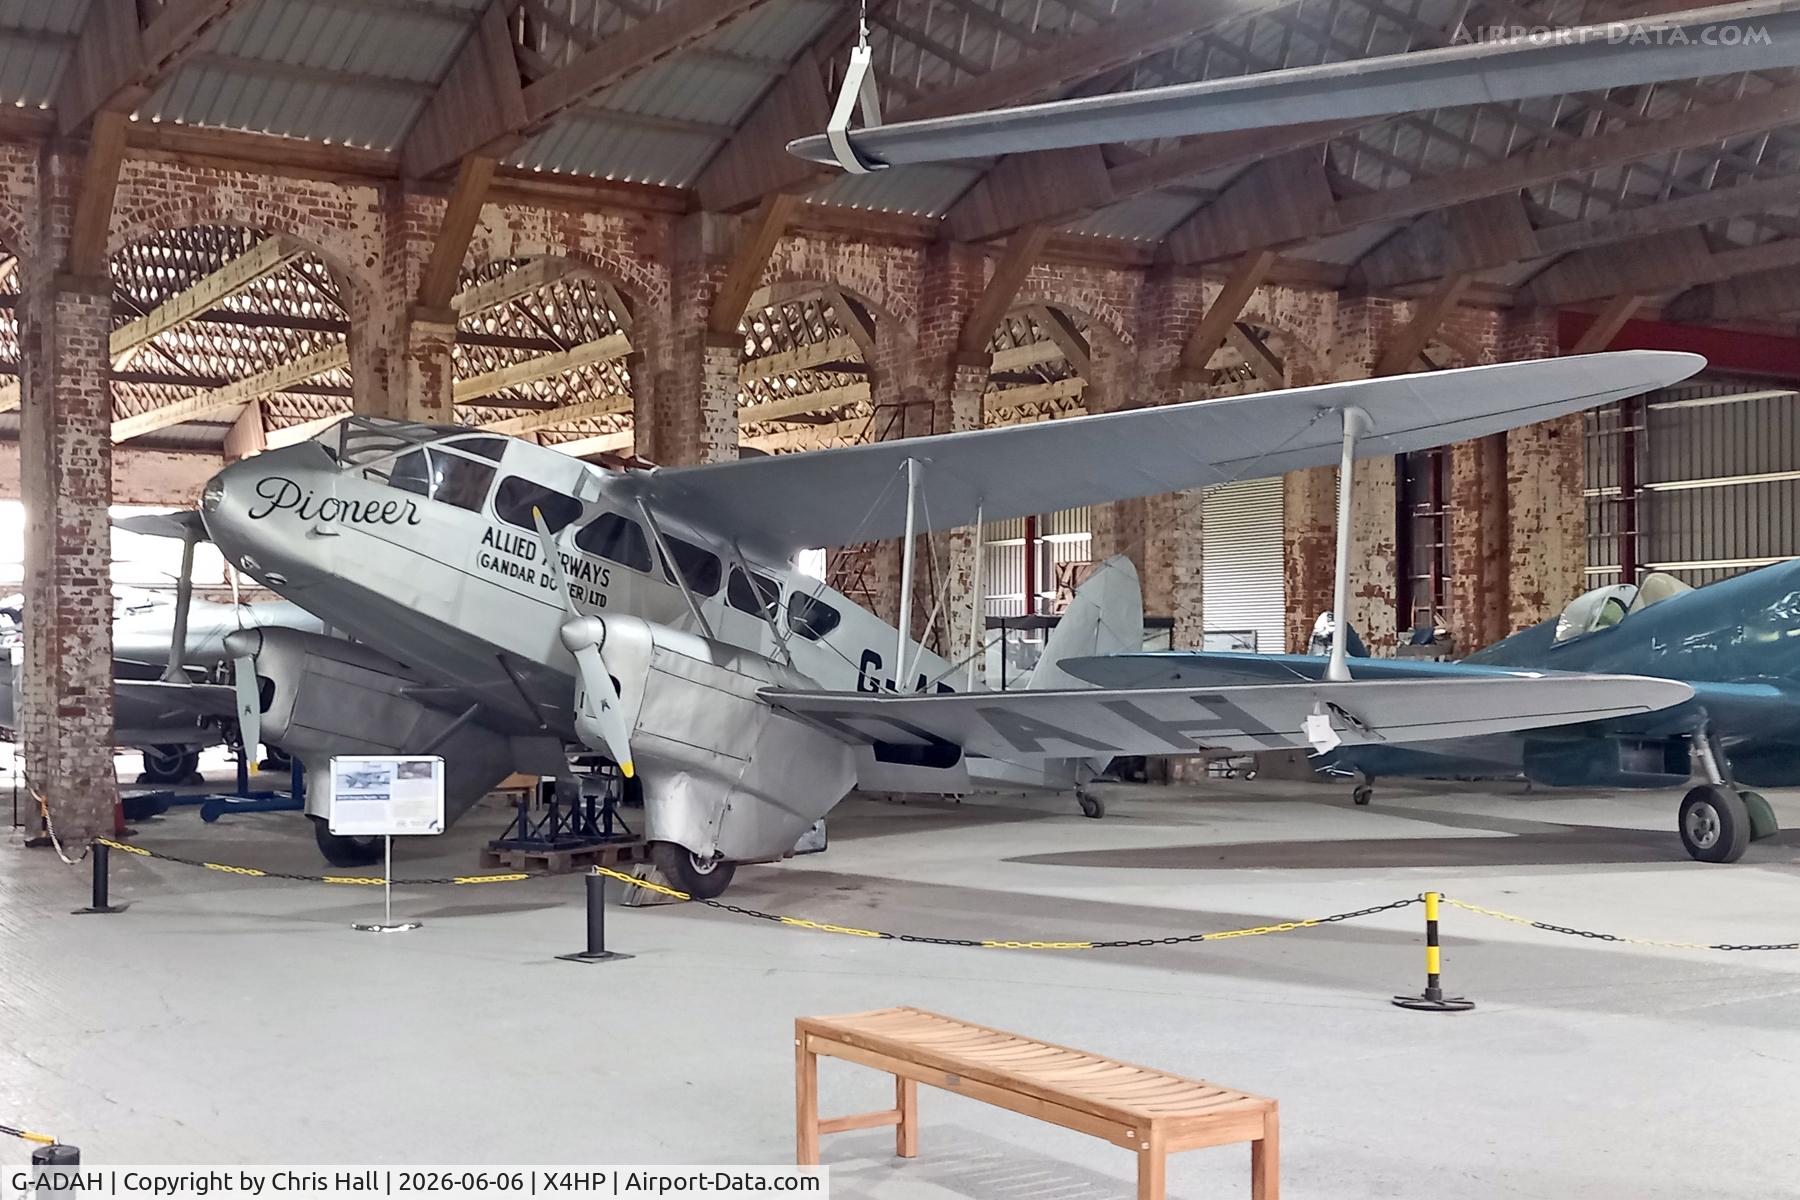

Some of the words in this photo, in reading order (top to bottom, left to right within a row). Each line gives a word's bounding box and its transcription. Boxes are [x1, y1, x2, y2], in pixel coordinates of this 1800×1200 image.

[248, 476, 421, 526] Pioneer
[481, 526, 537, 561] ALLIED
[476, 549, 536, 585] (GANDAR
